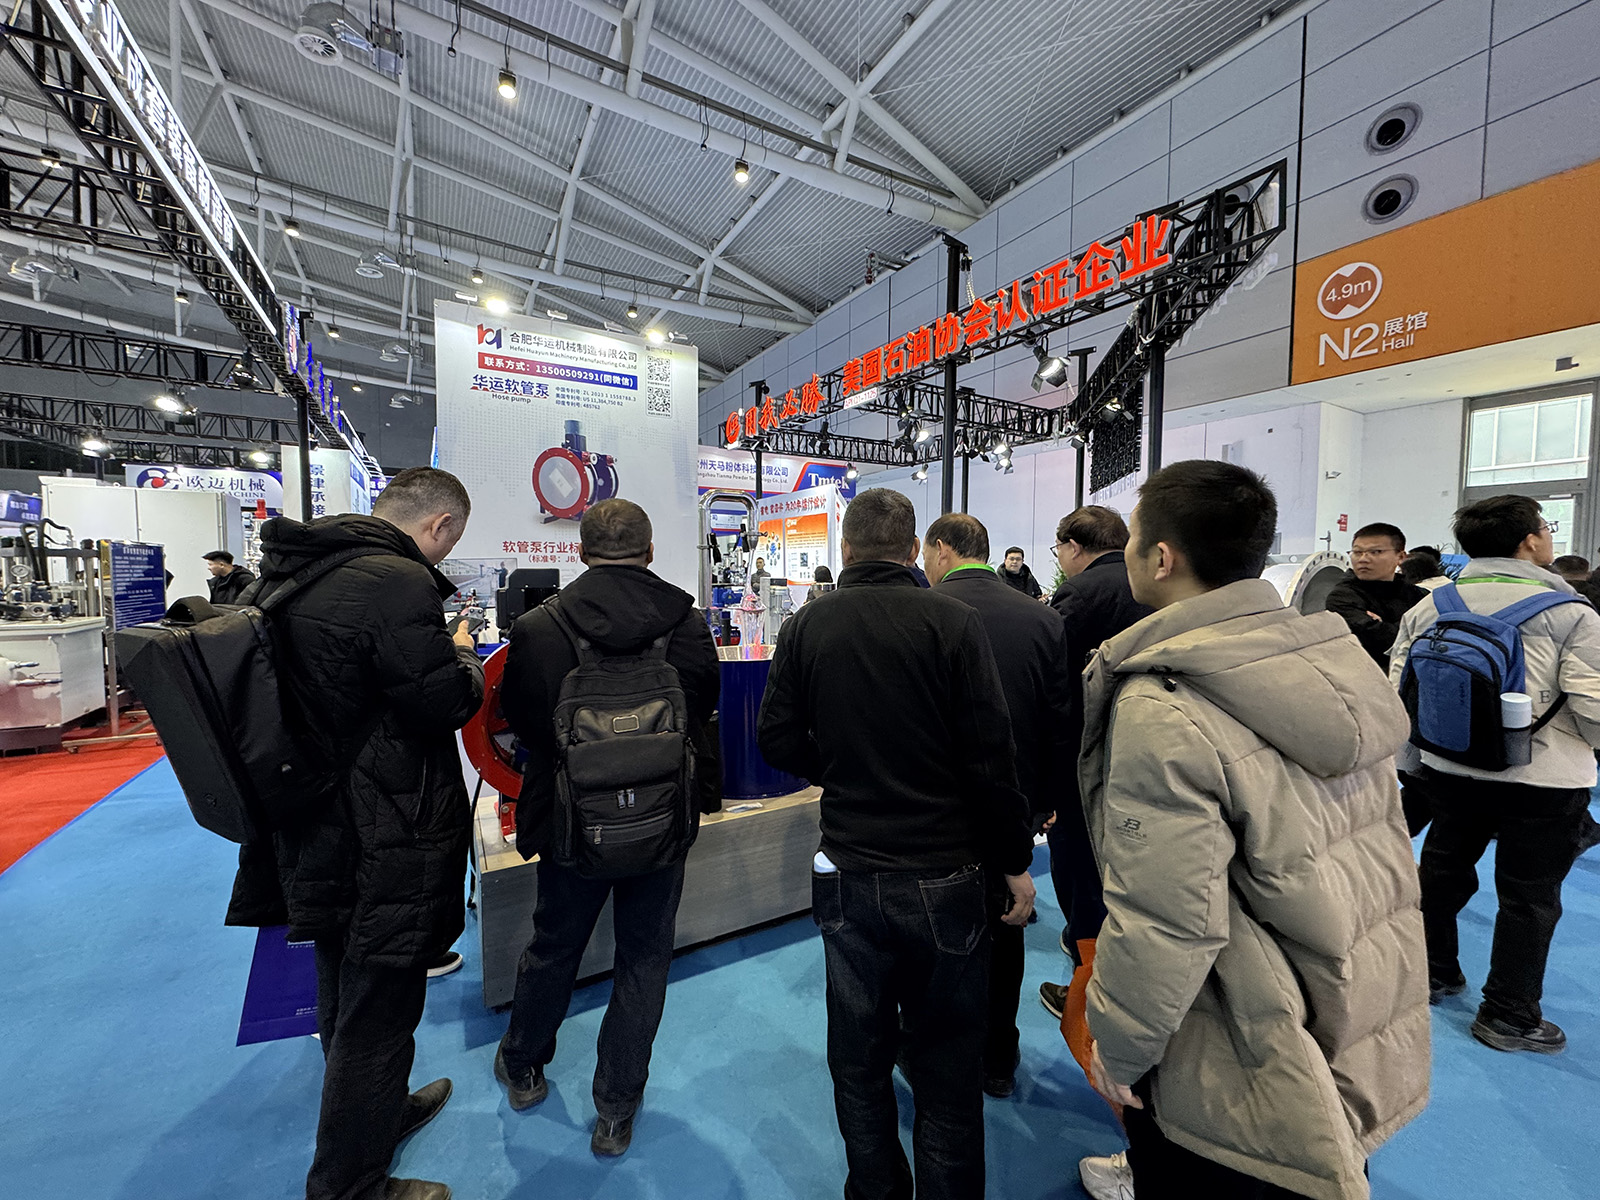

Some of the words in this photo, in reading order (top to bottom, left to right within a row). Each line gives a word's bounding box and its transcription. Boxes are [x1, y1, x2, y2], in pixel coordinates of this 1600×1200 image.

[74, 0, 234, 251] 业成套装备制造商
[1326, 280, 1372, 302] 4.9m
[842, 214, 1171, 396] 美国石油协会认证企业
[510, 332, 638, 363] 合肥华运机械制造有限公司
[1319, 323, 1379, 366] N2
[1383, 311, 1428, 337] 展馆
[1382, 334, 1415, 352] Hall
[550, 352, 579, 361] Machinery
[473, 374, 549, 397] 华运软管泵
[492, 393, 510, 401] Hose
[511, 396, 531, 404] pump
[697, 459, 789, 477] 州天马粉体科技有限公司
[186, 475, 266, 492] 欧迈机械
